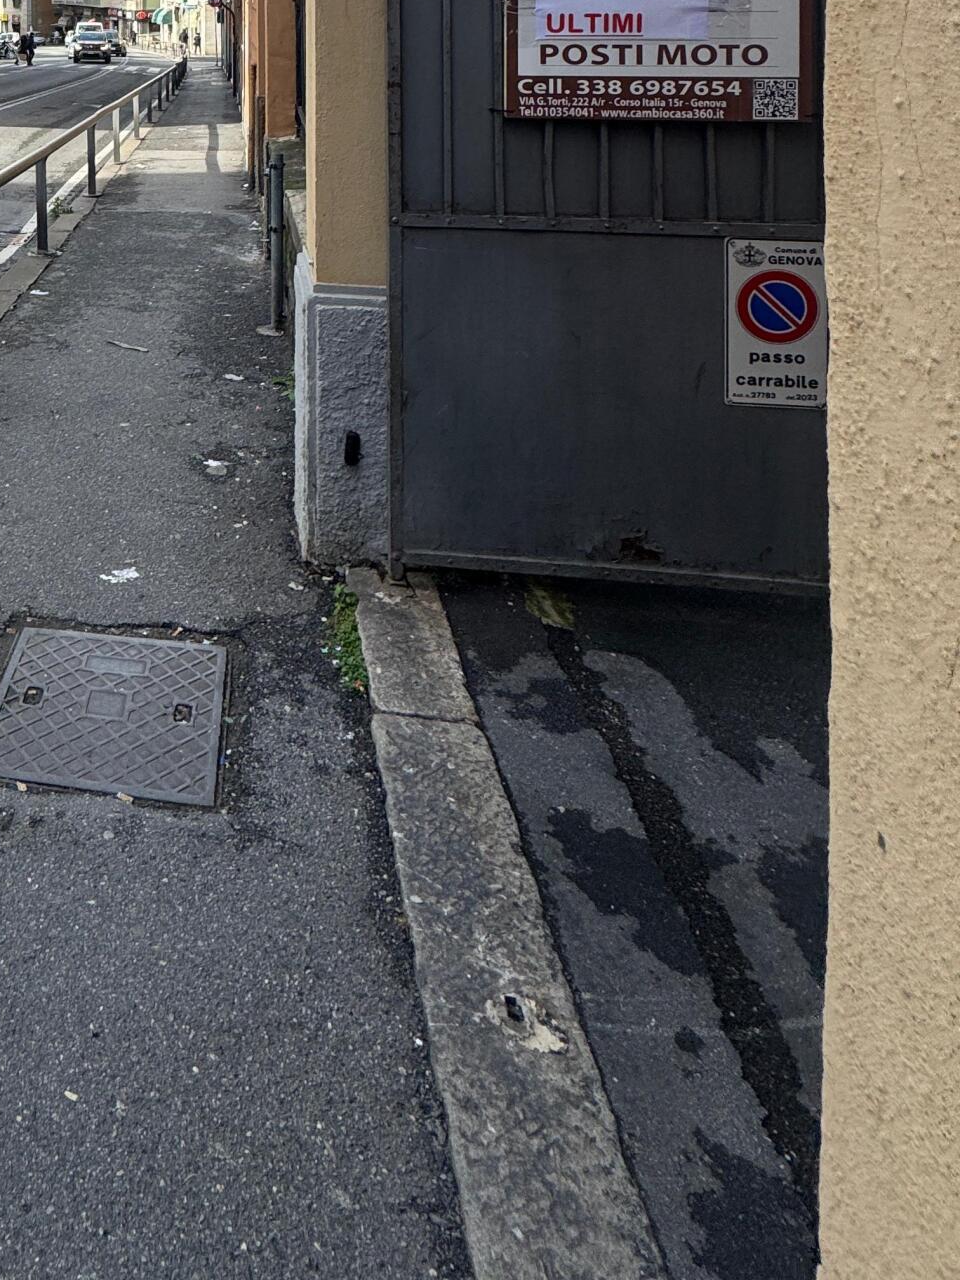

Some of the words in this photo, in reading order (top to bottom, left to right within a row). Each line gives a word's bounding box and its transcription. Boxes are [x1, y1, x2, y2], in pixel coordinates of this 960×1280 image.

[545, 12, 644, 34] ULTIMI
[539, 43, 644, 66] POSTI
[655, 43, 770, 66] MOTO
[517, 78, 570, 96] Cell.
[576, 79, 622, 96] 338
[628, 80, 743, 97] 6987654
[519, 96, 537, 106] VIA
[571, 97, 589, 106] 222
[591, 97, 605, 107] A/r
[614, 97, 640, 108] Corso
[642, 97, 666, 108] Italia
[668, 98, 684, 108] 15r
[690, 99, 727, 109] Genova
[601, 107, 725, 119] www.cambiocasa360.it
[774, 246, 807, 254] Comune
[809, 247, 817, 255] di
[767, 255, 823, 267] GENOVA
[749, 351, 806, 365] passo
[735, 373, 819, 390] carrabile
